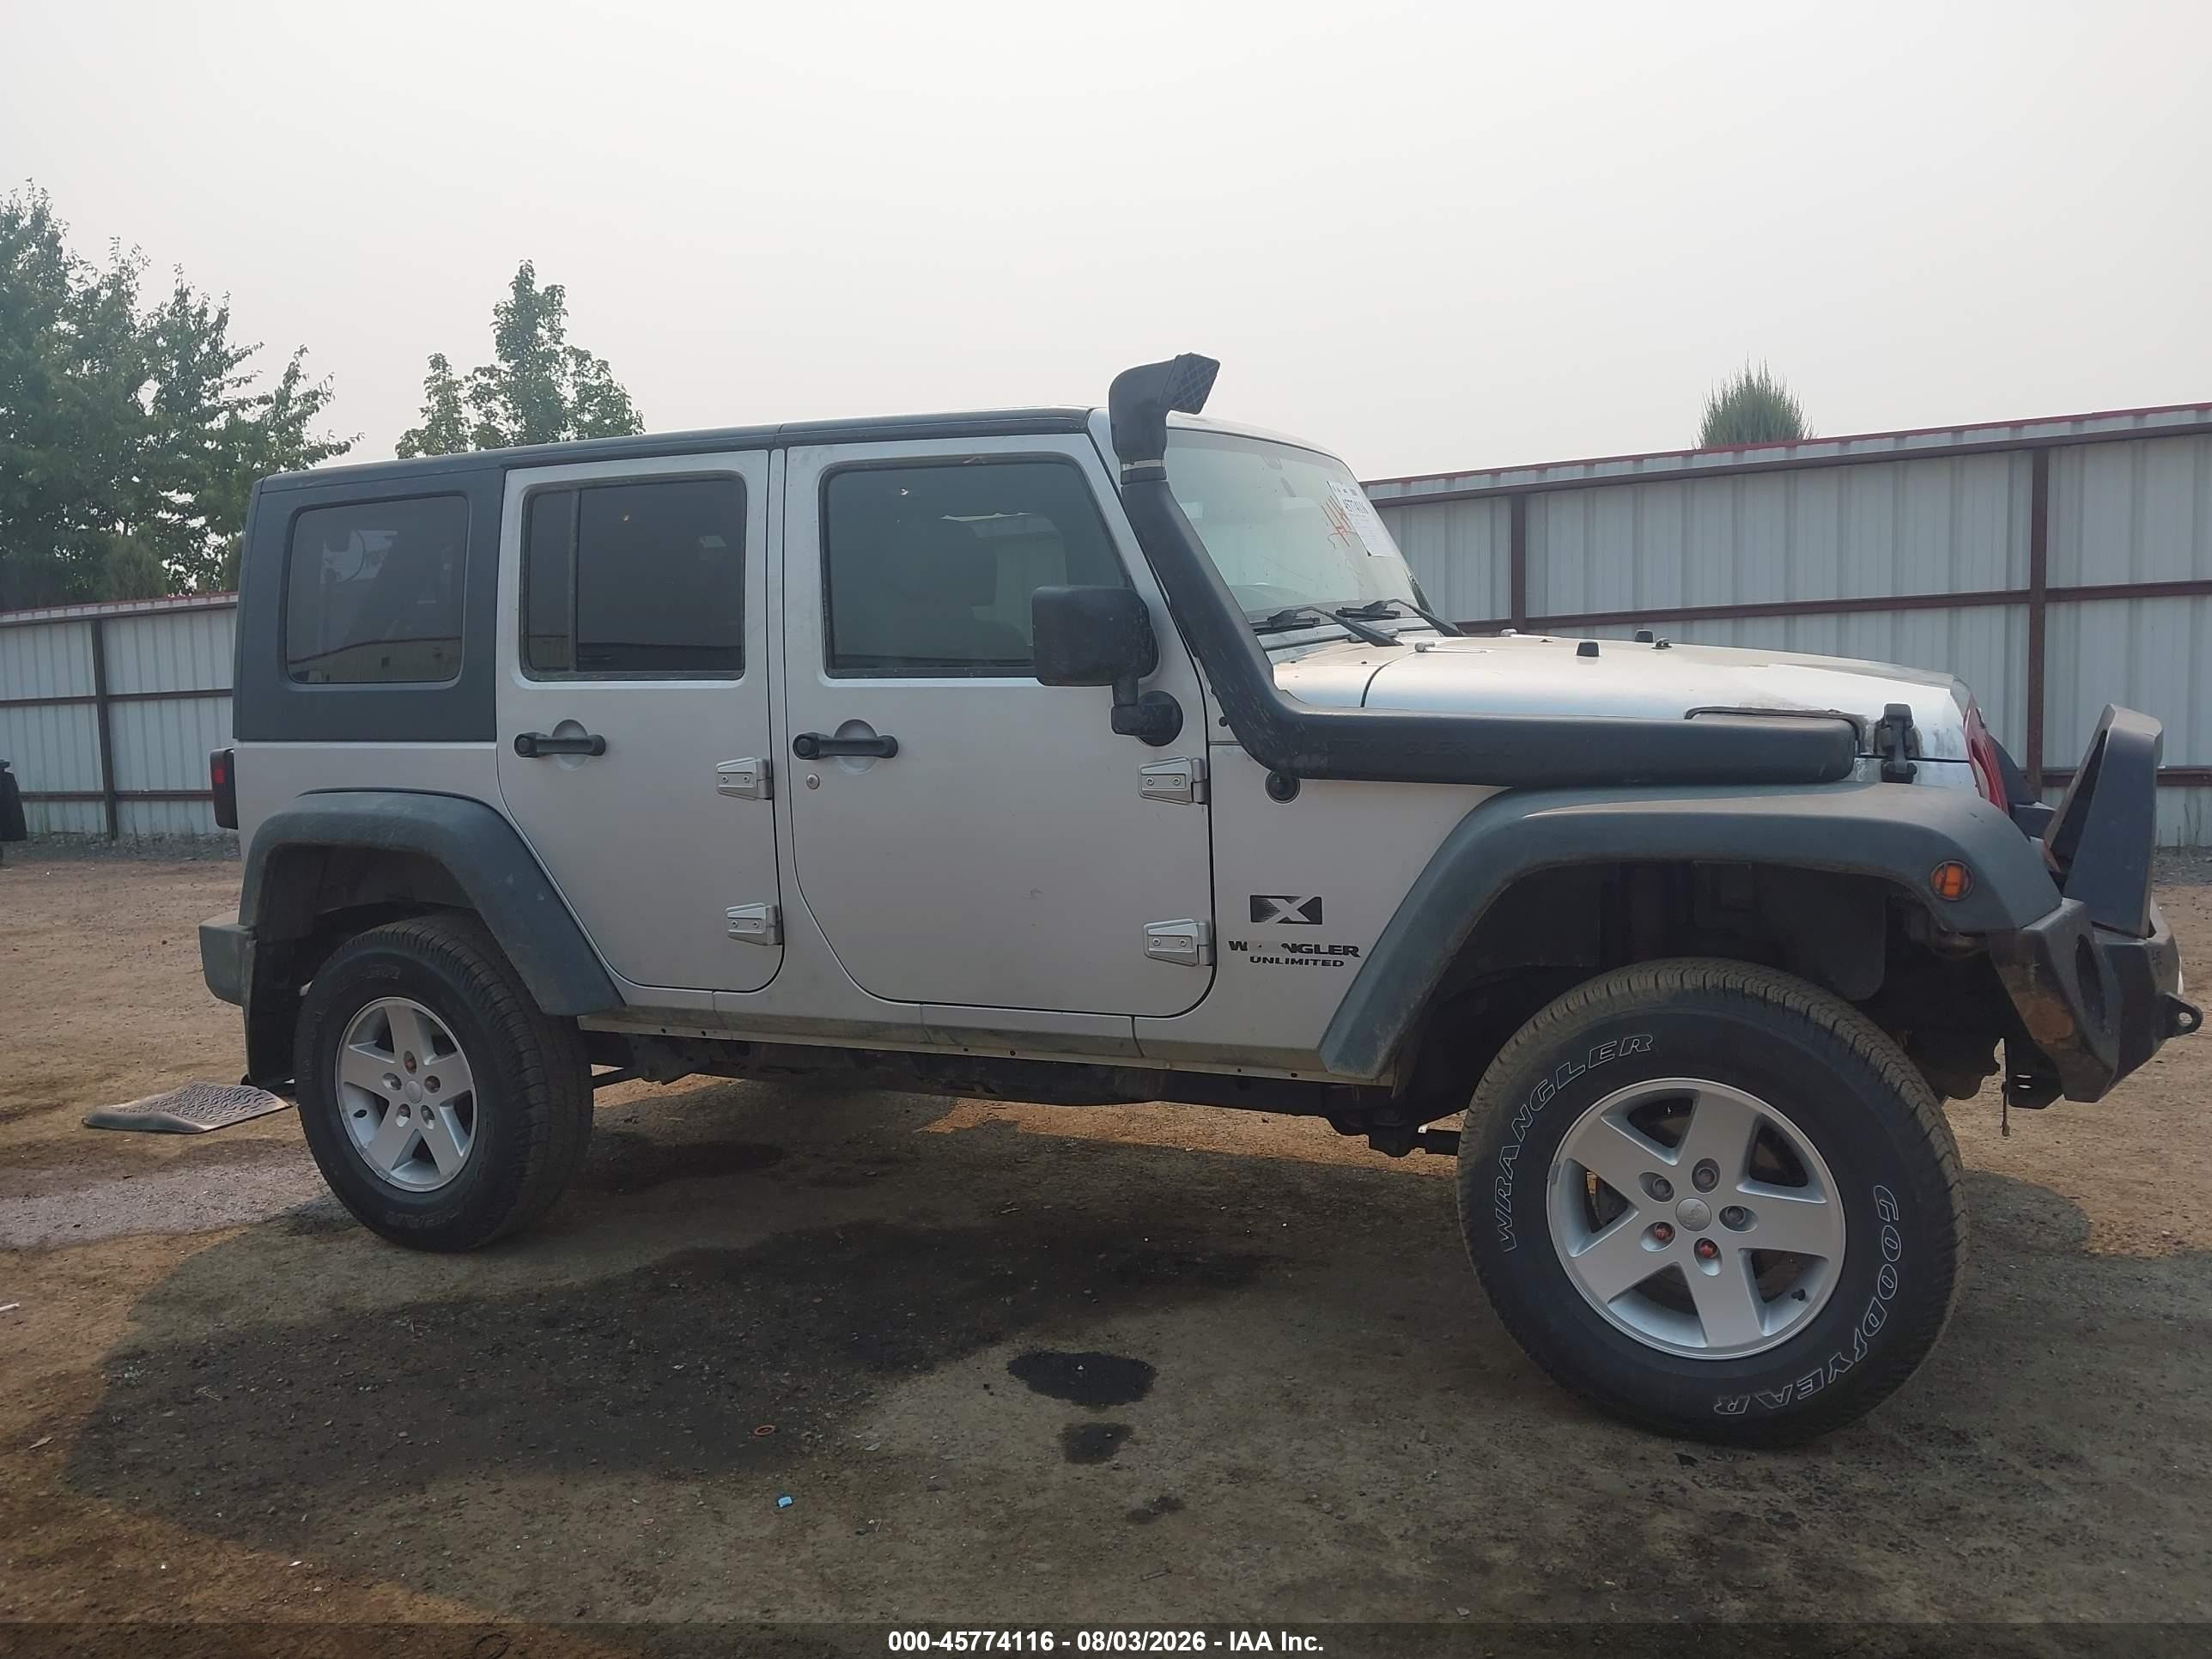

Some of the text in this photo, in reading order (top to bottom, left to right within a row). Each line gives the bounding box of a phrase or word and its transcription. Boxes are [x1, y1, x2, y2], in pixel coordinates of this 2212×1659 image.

[1249, 956, 1345, 967] UNLIMITED
[1492, 1033, 1655, 1253] WRANGLER
[1713, 1184, 1902, 1416] GOODYEAR
